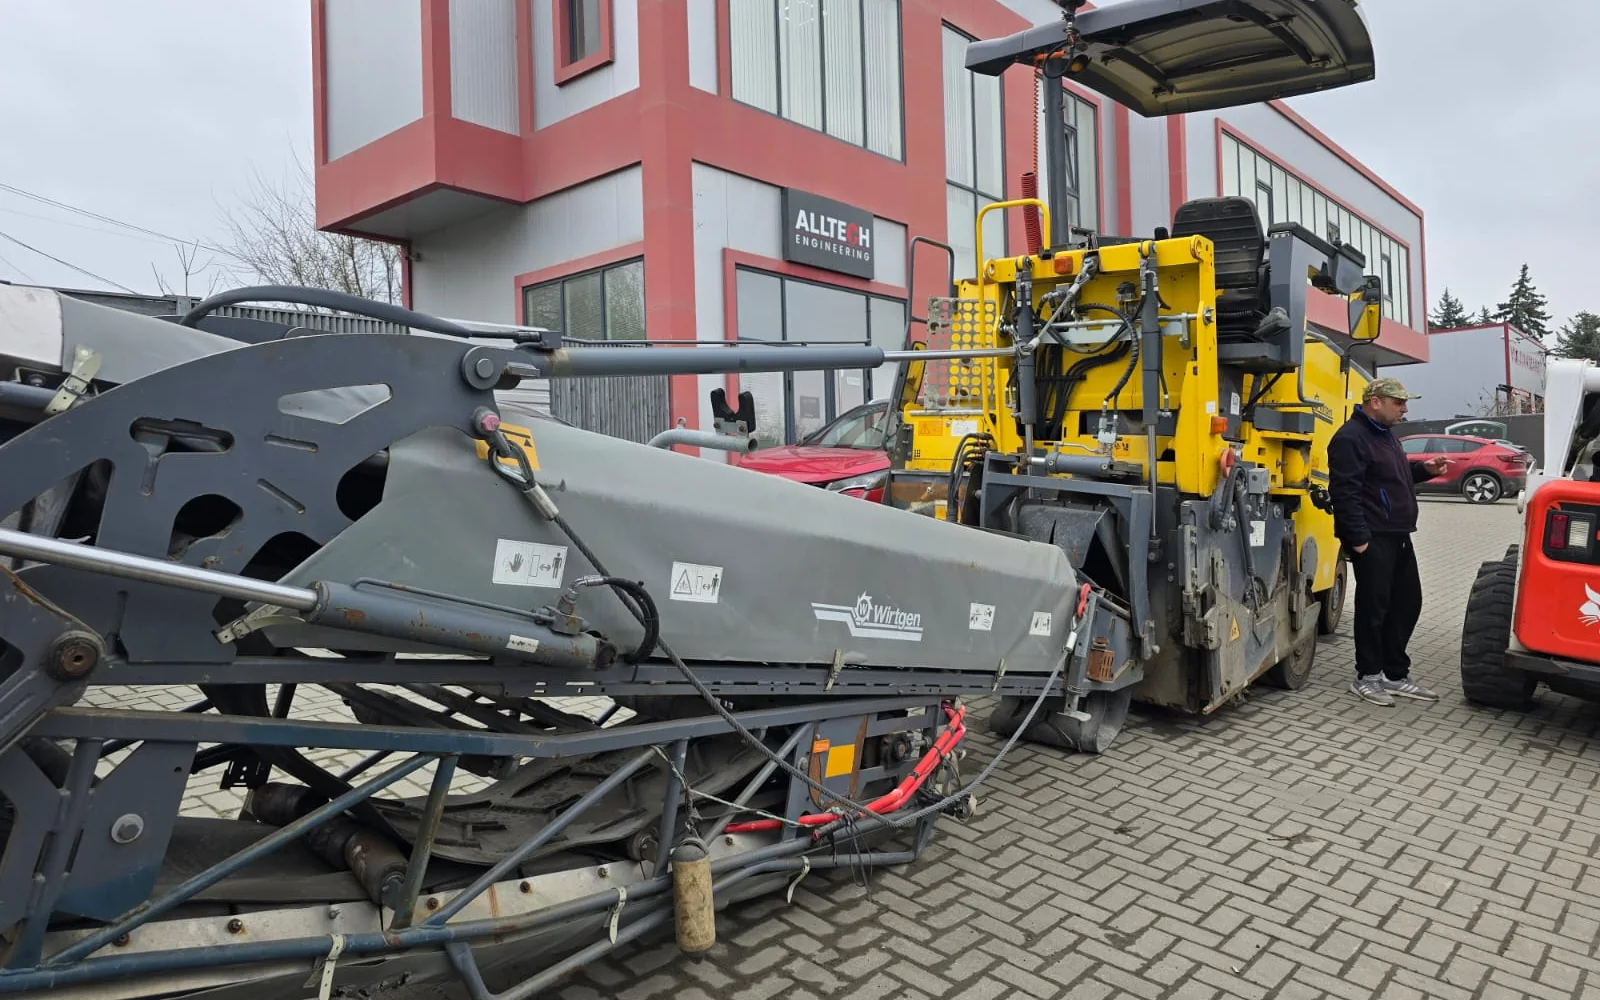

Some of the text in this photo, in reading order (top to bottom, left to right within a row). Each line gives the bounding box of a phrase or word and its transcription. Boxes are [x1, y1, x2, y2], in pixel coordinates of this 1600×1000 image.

[795, 209, 870, 248] ALLTECH
[795, 234, 870, 261] ENGINEERING
[874, 604, 921, 630] Wirtgen
